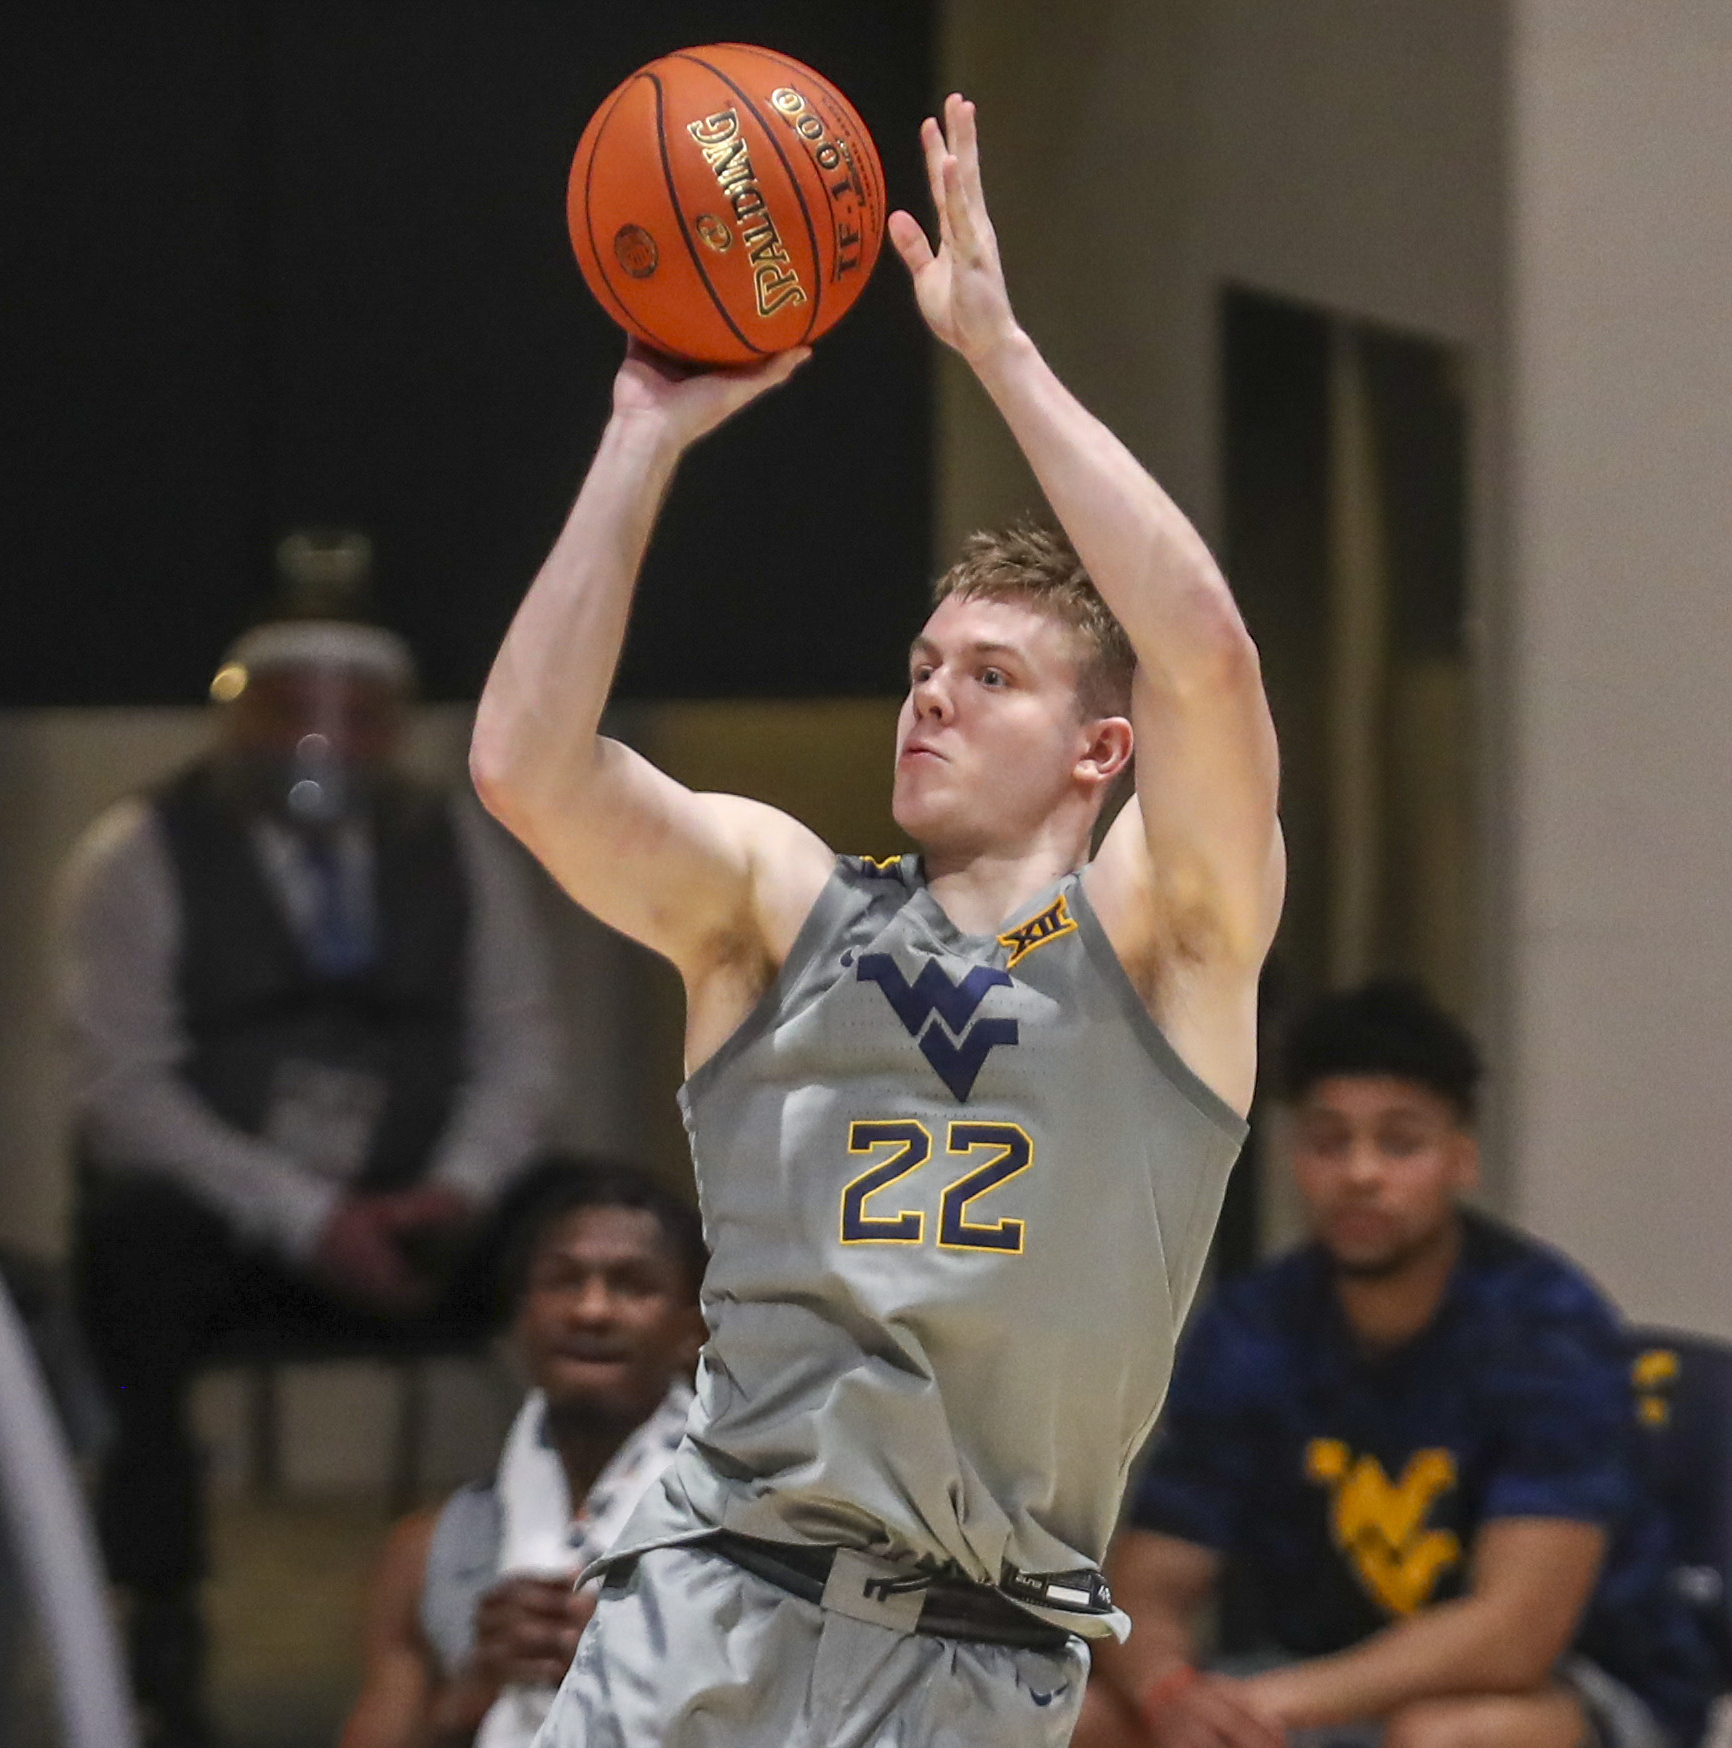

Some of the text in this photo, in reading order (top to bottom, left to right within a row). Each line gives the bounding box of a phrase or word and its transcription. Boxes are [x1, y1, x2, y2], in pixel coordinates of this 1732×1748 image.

[686, 106, 808, 318] SPALDING
[770, 86, 865, 283] TF-1000
[999, 896, 1075, 967] XII
[839, 1118, 1034, 1255] 22
